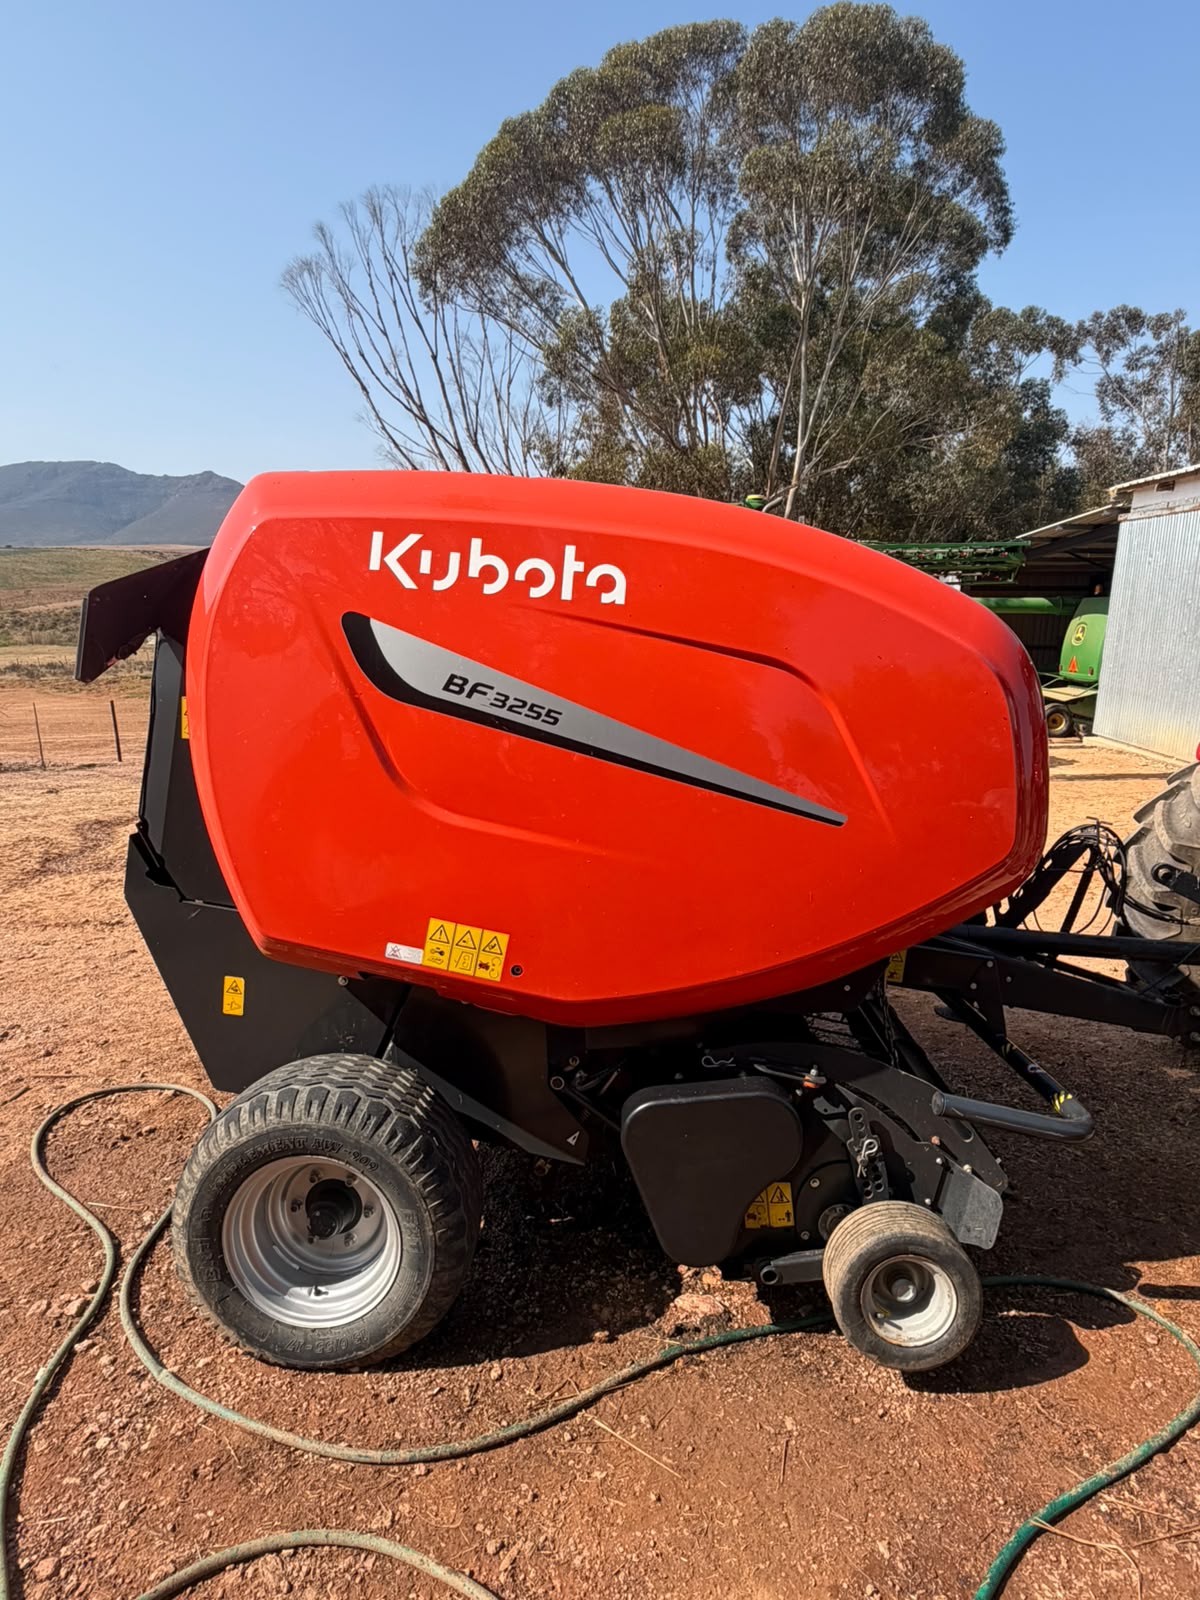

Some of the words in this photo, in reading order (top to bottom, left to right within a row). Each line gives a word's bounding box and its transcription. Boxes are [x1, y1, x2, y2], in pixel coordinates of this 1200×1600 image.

[369, 531, 627, 605] Kubota
[442, 673, 562, 726] BF3255
[210, 1137, 308, 1194] IMPLEMENT
